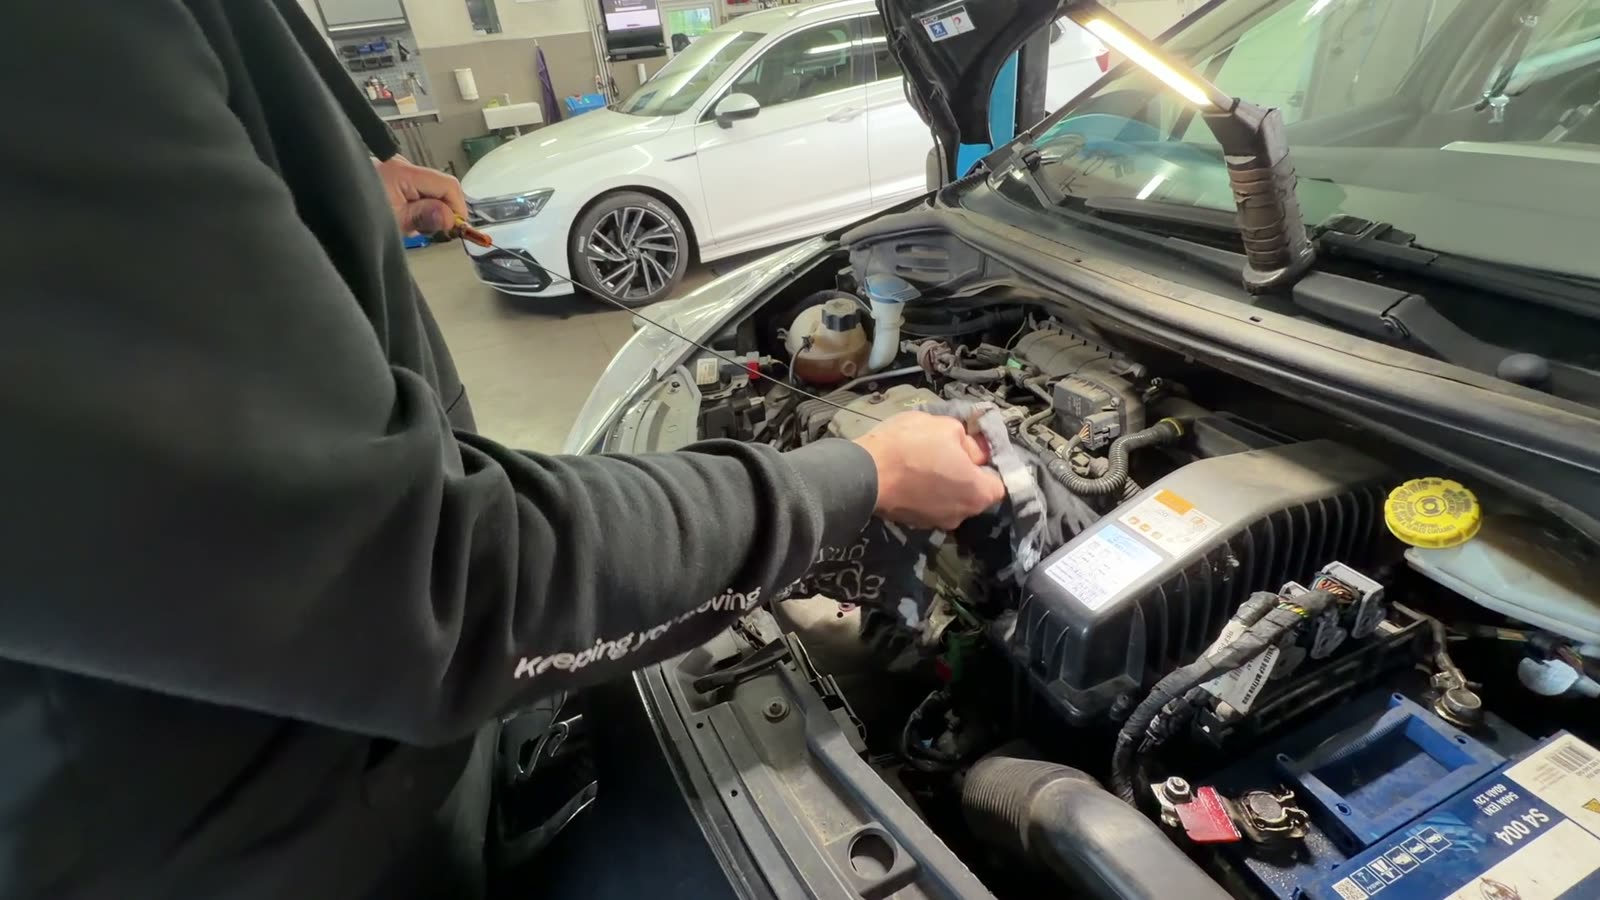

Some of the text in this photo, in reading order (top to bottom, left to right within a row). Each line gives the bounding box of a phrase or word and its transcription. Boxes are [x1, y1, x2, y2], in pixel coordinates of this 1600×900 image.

[678, 587, 761, 621] oving
[1473, 783, 1507, 806] 60Ah 12V
[1494, 807, 1550, 846] S4 004
